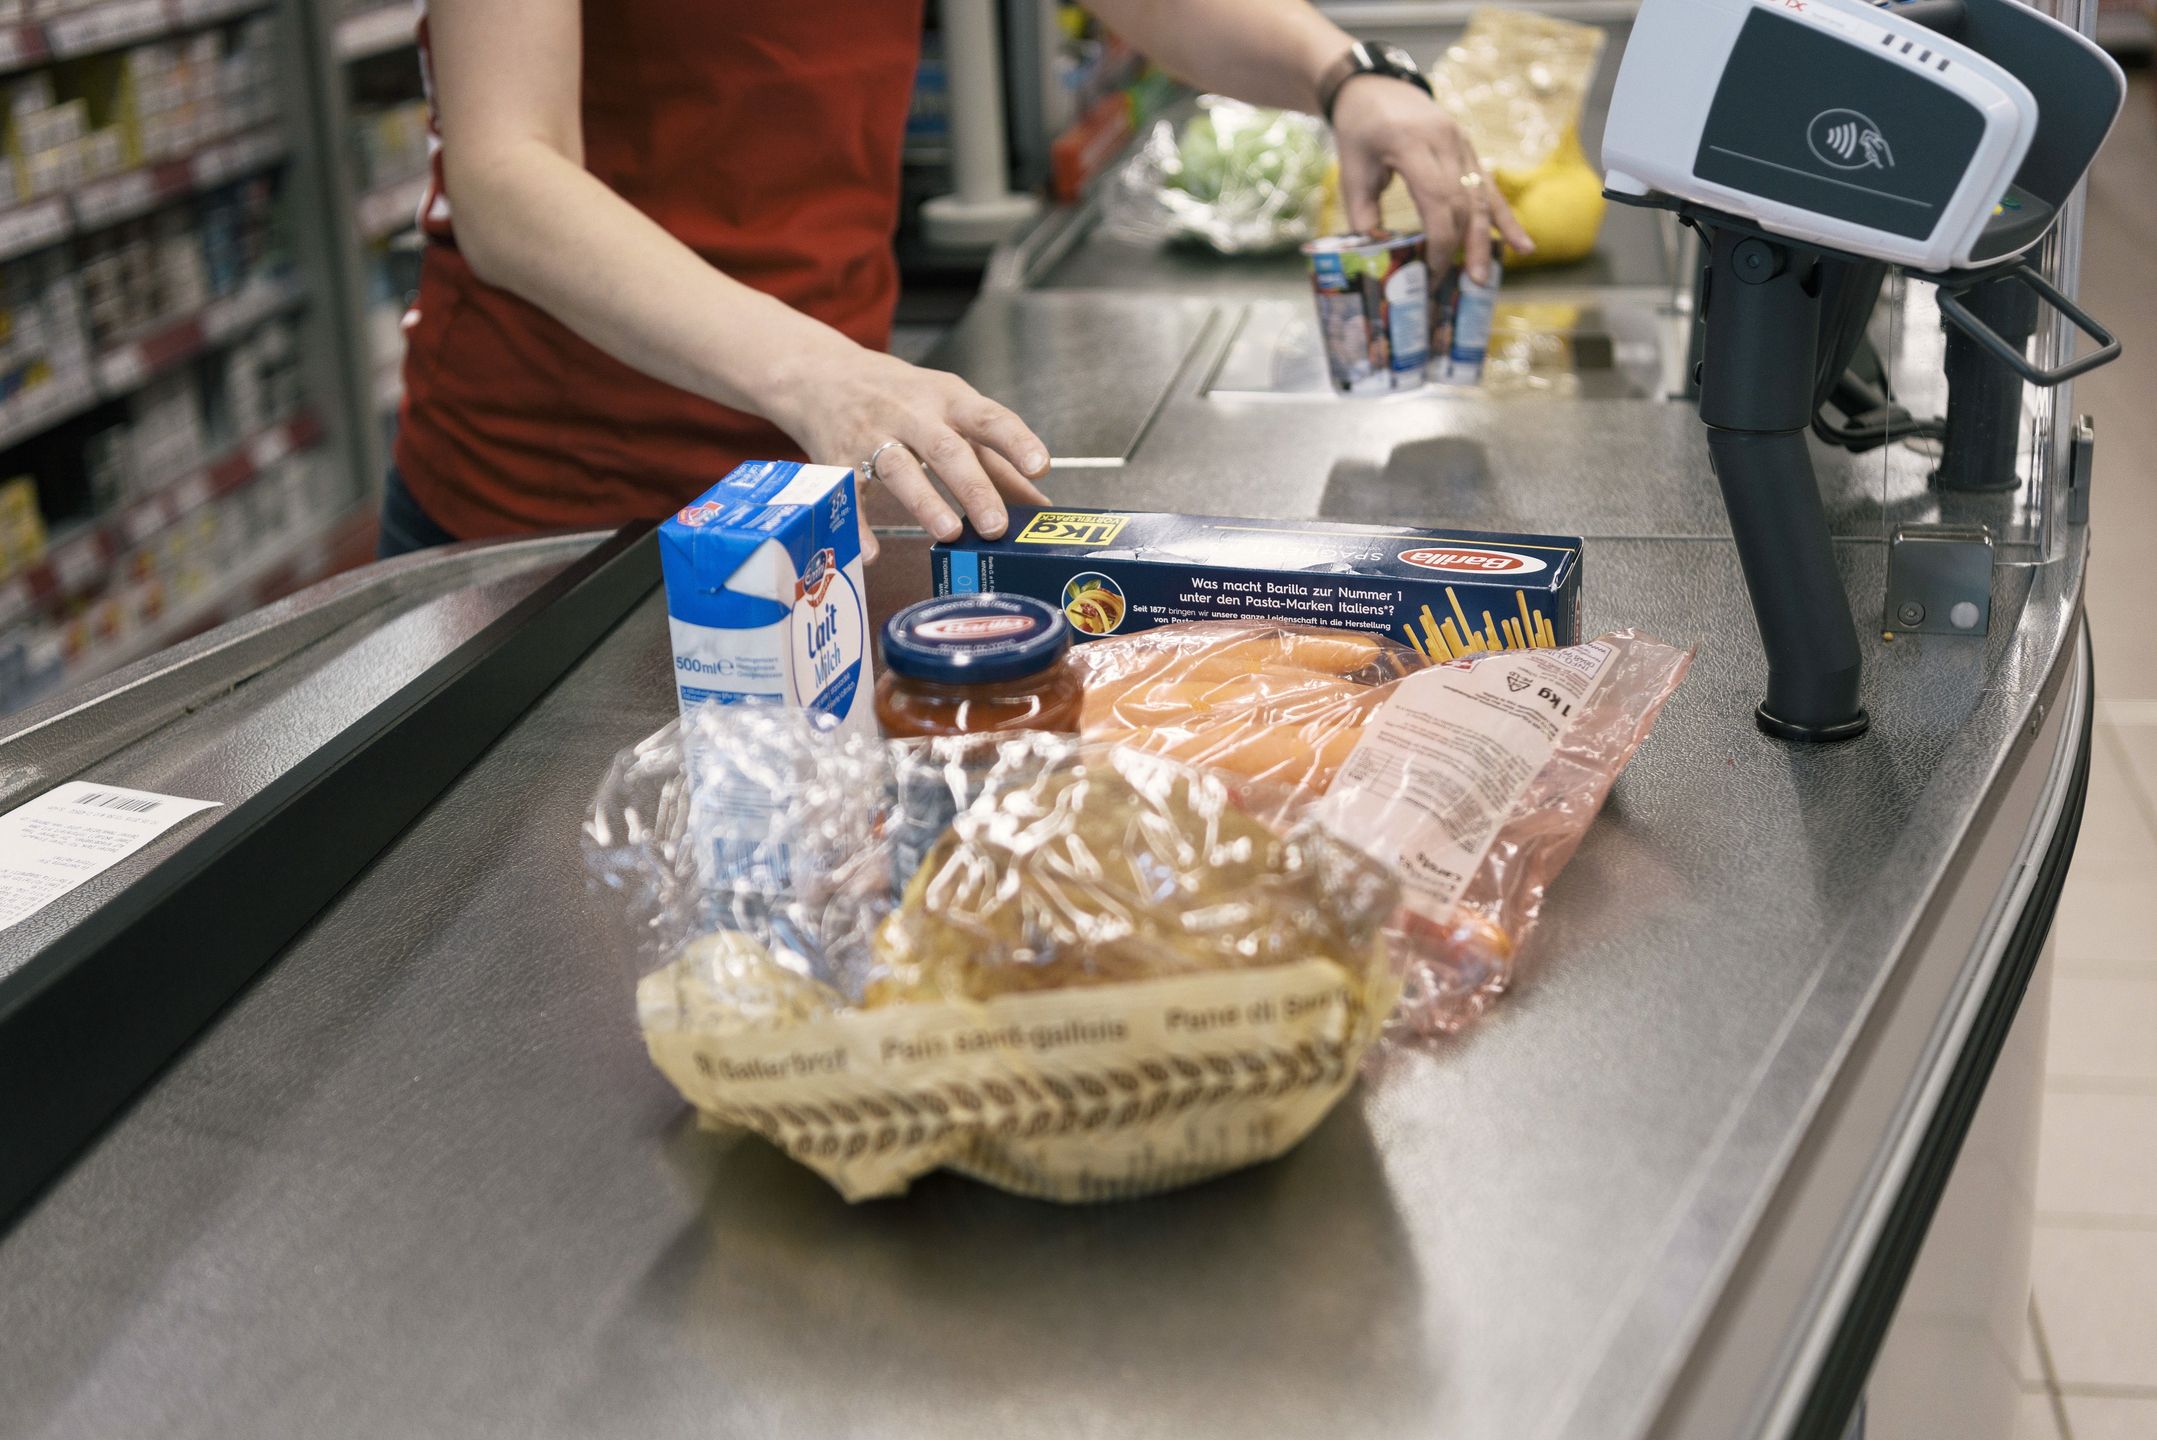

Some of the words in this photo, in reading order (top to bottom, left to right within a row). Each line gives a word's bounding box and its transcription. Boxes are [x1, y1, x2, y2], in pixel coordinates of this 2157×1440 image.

[1038, 513, 1120, 525] VORTEILSPACK
[1410, 552, 1511, 571] Barilla
[1191, 577, 1218, 589] Was
[1223, 581, 1262, 593] macht
[1267, 582, 1308, 596] Barilla
[1313, 587, 1333, 597] zur
[1338, 587, 1393, 601] Nummer
[1397, 590, 1402, 602] 1
[1179, 592, 1211, 603] unter
[1217, 594, 1240, 605] den
[1246, 596, 1333, 612] Pasta-Marken
[1133, 604, 1148, 613] Seit
[1150, 605, 1166, 614] 1877
[1168, 607, 1196, 617] bringen
[1211, 610, 1238, 619] unsere
[1267, 614, 1318, 625] Leidenschaft
[1330, 618, 1343, 627] die
[1345, 619, 1391, 631] Herstellung
[1153, 616, 1168, 624] von
[806, 602, 837, 660] Lait
[676, 656, 718, 675] 500ml
[813, 641, 841, 690] Milch
[1537, 687, 1562, 709] kg
[1561, 704, 1572, 717] 1
